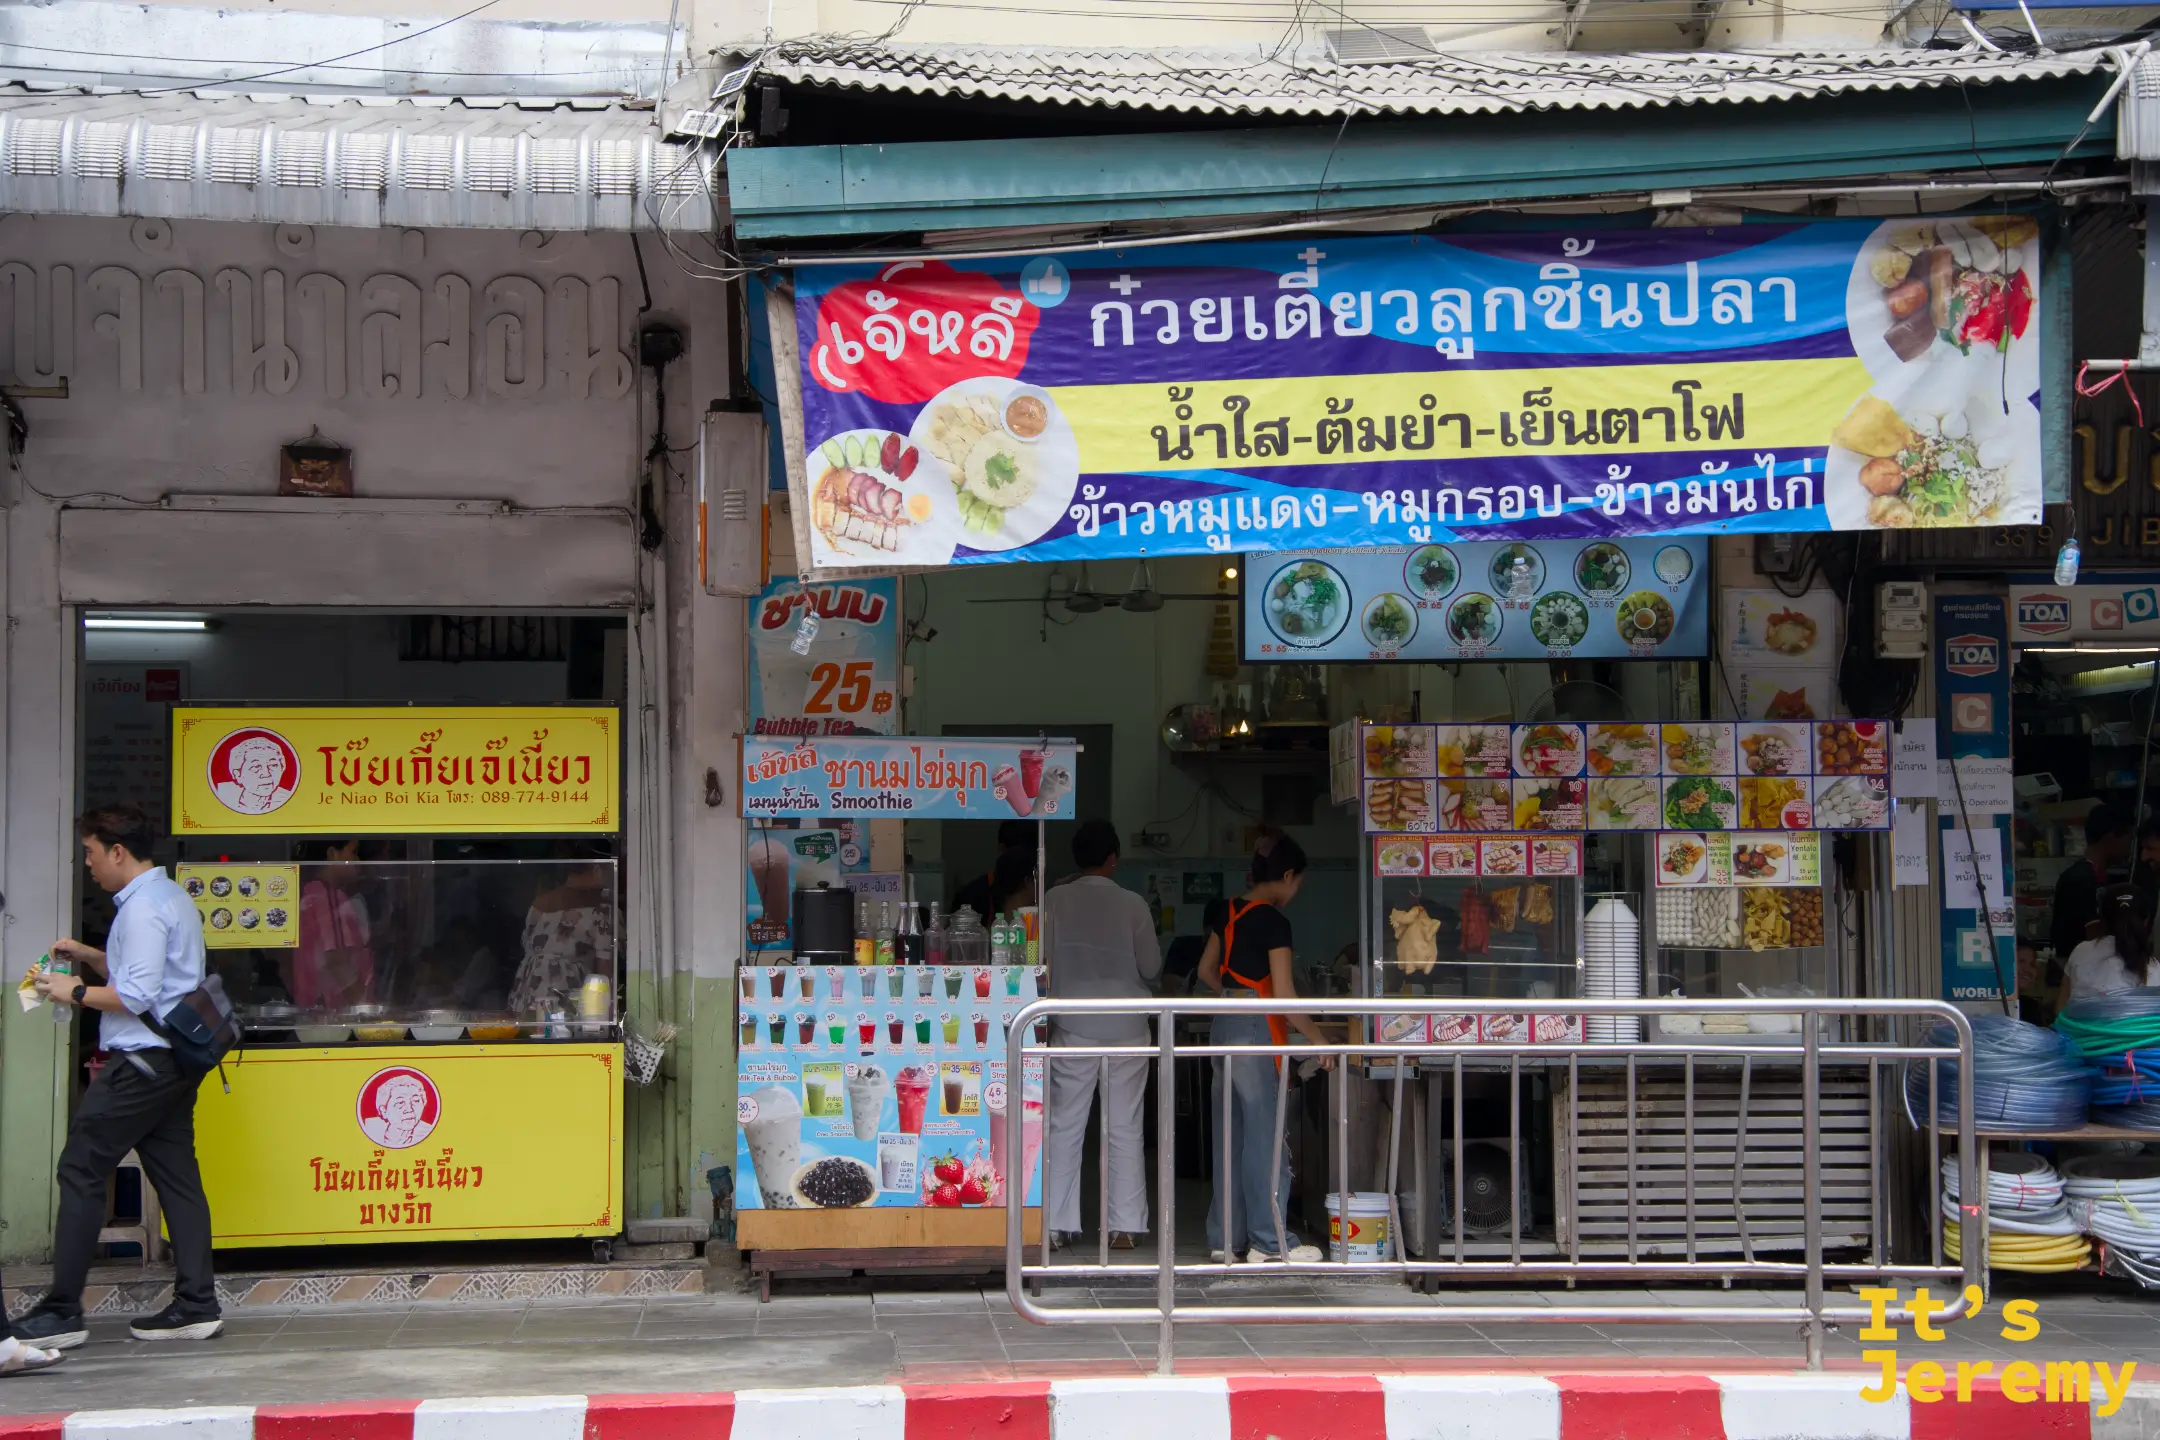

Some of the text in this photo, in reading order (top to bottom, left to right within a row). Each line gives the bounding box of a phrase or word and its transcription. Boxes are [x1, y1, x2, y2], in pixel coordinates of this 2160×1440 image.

[830, 238, 1797, 365] เจ้หลี ก๋วยเตี๋ยวลูกชิ้นปลา
[1150, 379, 1745, 462] น้ำใส-ต้มยำ-เย็นตาโฟ
[1068, 454, 1814, 552] ข้าวหมูแดง-หมูกรอบ-ข้าวมันไก่
[761, 586, 884, 631] ชานม
[2021, 604, 2067, 621] TOA
[1950, 647, 1995, 664] TOA
[1957, 697, 1987, 729] C
[754, 717, 855, 735] Bubble Tea
[1724, 726, 1730, 736] 5
[1799, 726, 1806, 735] 6
[1874, 725, 1881, 735] 7
[1425, 729, 1432, 739] 1
[1498, 729, 1505, 738] 2
[1573, 728, 1580, 738] 3
[1648, 727, 1655, 737] 4
[824, 747, 987, 807] ชานมไข่มุก
[1425, 783, 1432, 793] 8
[1499, 782, 1506, 792] 9
[1569, 781, 1581, 792] 10
[1645, 782, 1655, 791] 11
[1719, 781, 1731, 790] 12
[1795, 780, 1807, 790] 13
[1871, 779, 1884, 790] 14
[317, 791, 333, 805] Je
[341, 790, 377, 804] Niao
[385, 790, 409, 804] Boi
[417, 790, 439, 804] Kia
[481, 790, 589, 804] 089-774-9144
[748, 787, 913, 815] เมนูน้ำปั่น Smoothie
[1937, 799, 1958, 807] CCTV
[1969, 799, 2008, 808] Operation
[1407, 822, 1435, 831] 60 70
[747, 1062, 787, 1073] ชานมไข่มุก
[753, 1074, 765, 1082] Tea
[774, 1073, 797, 1081] Bubble
[360, 1194, 431, 1225] บางรัก
